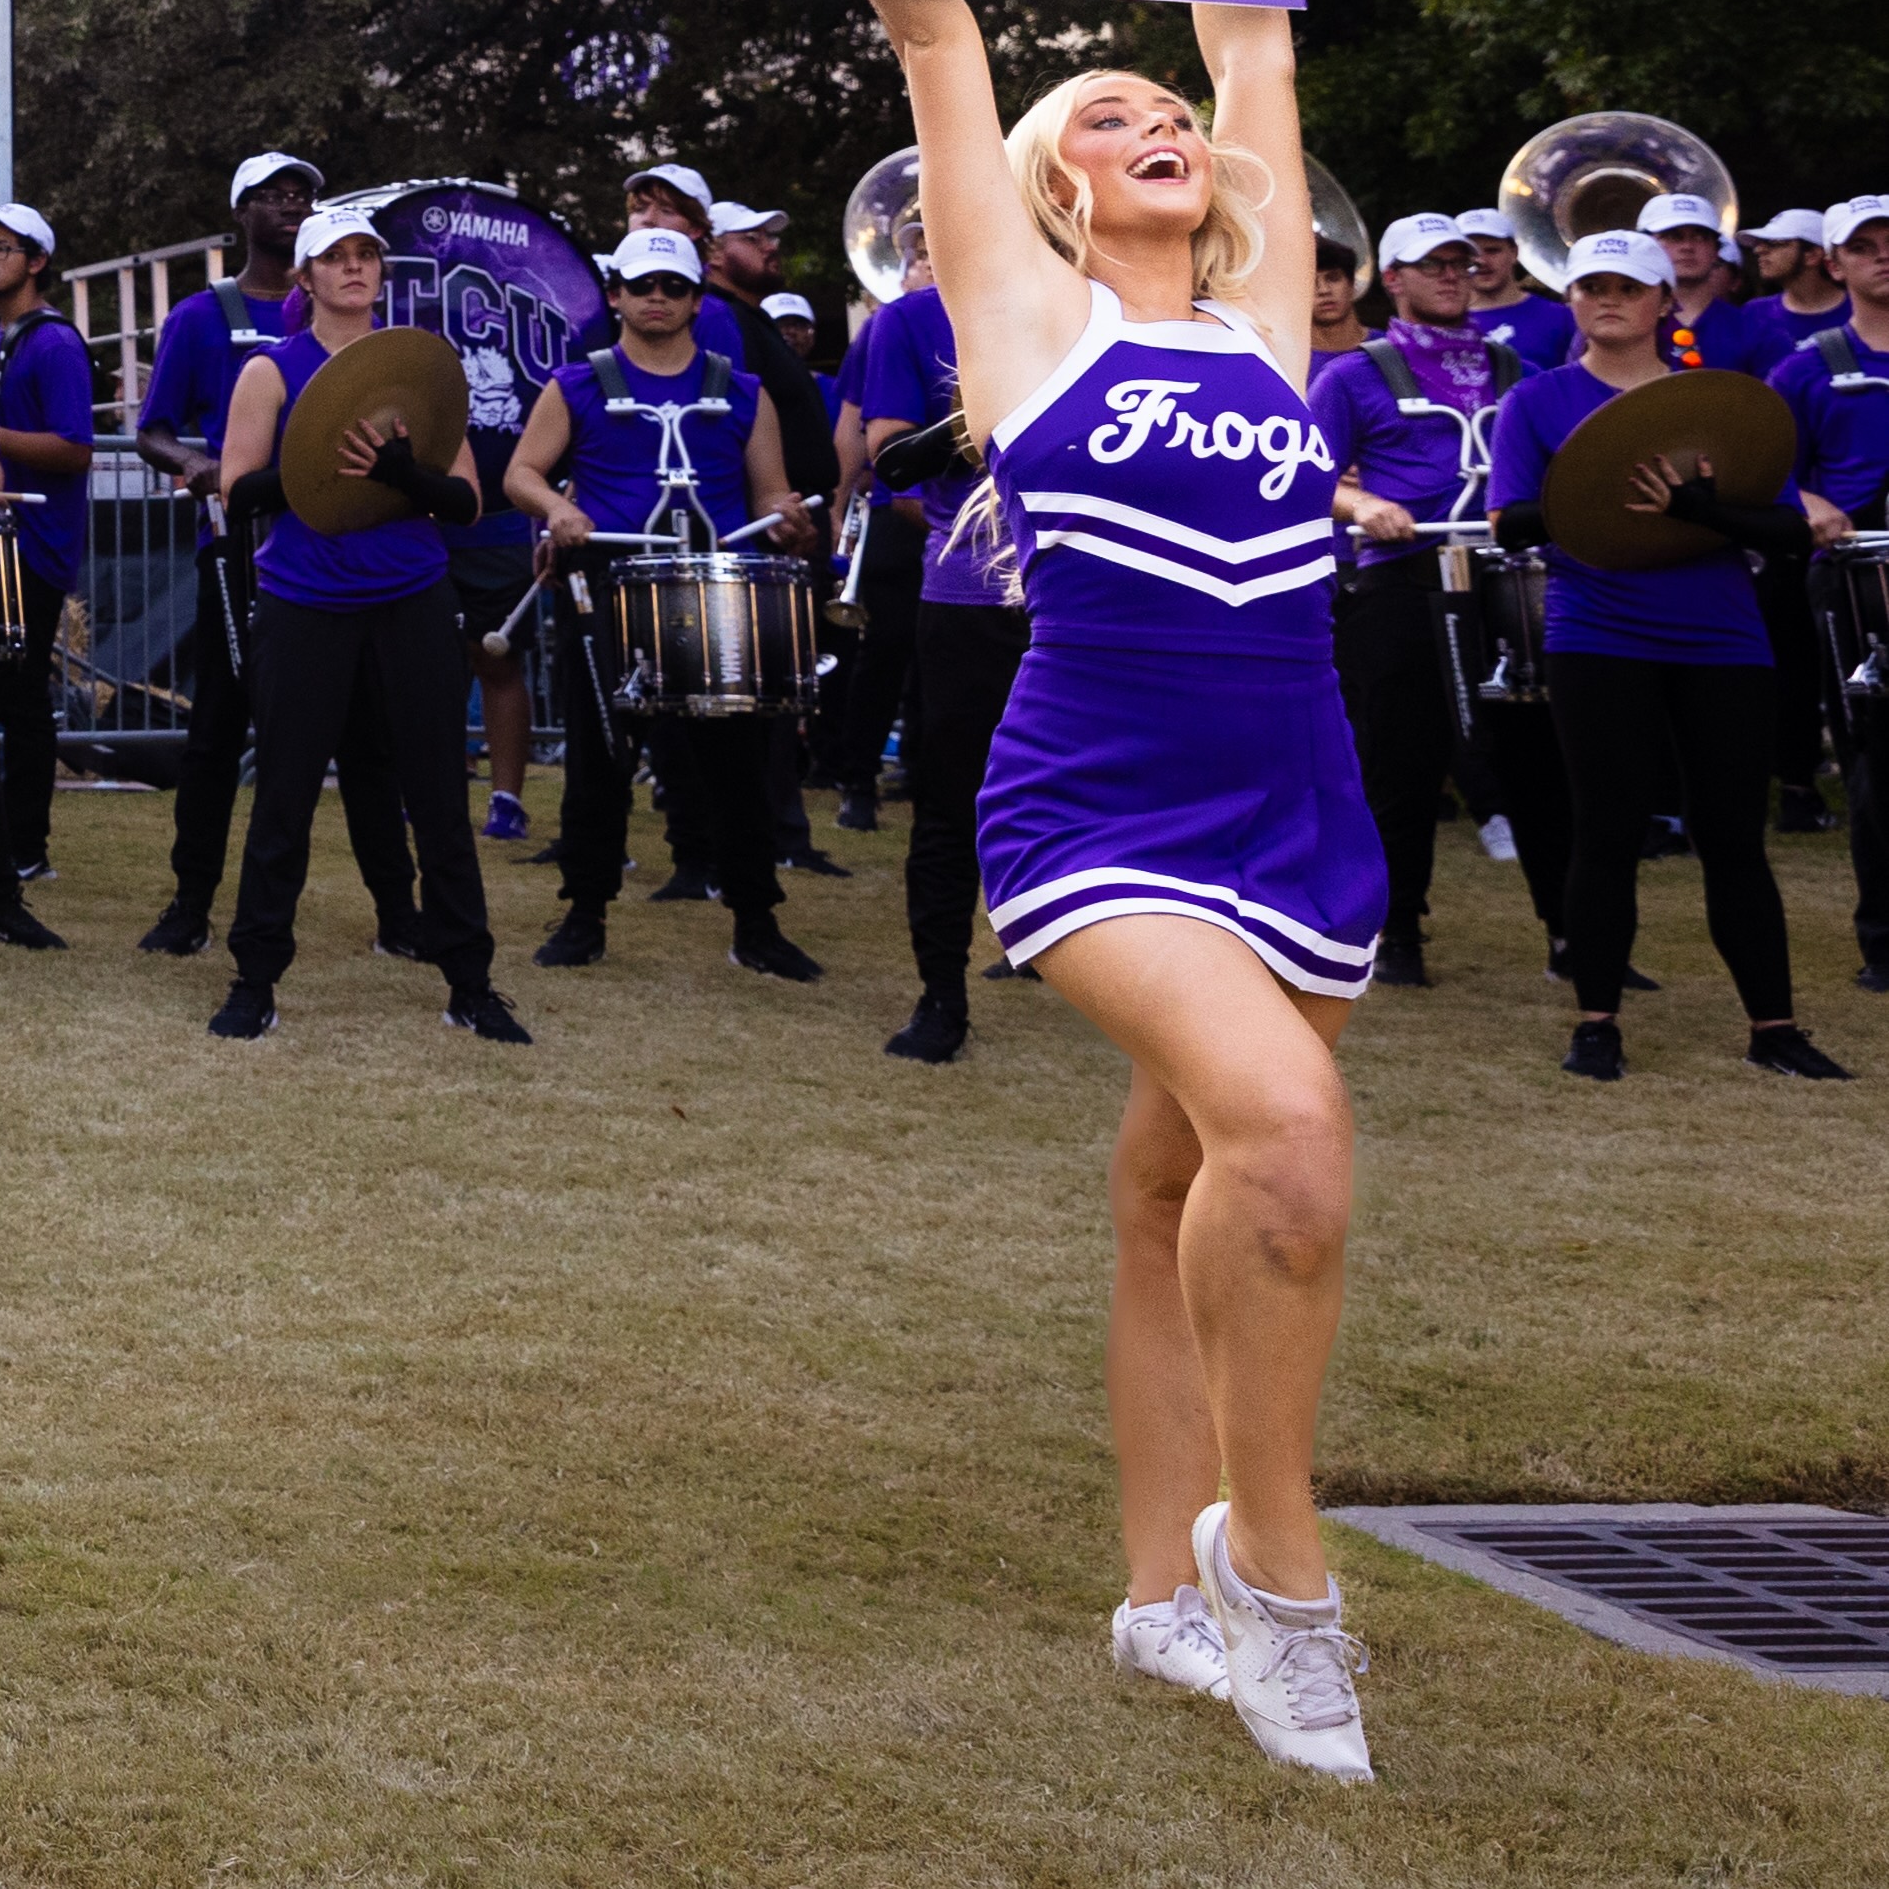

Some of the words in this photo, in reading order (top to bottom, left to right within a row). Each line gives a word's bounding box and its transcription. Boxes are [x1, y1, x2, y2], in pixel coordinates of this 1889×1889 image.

[449, 211, 529, 247] YAMAHA
[376, 256, 570, 390] TCU
[1089, 380, 1335, 501] Frogs
